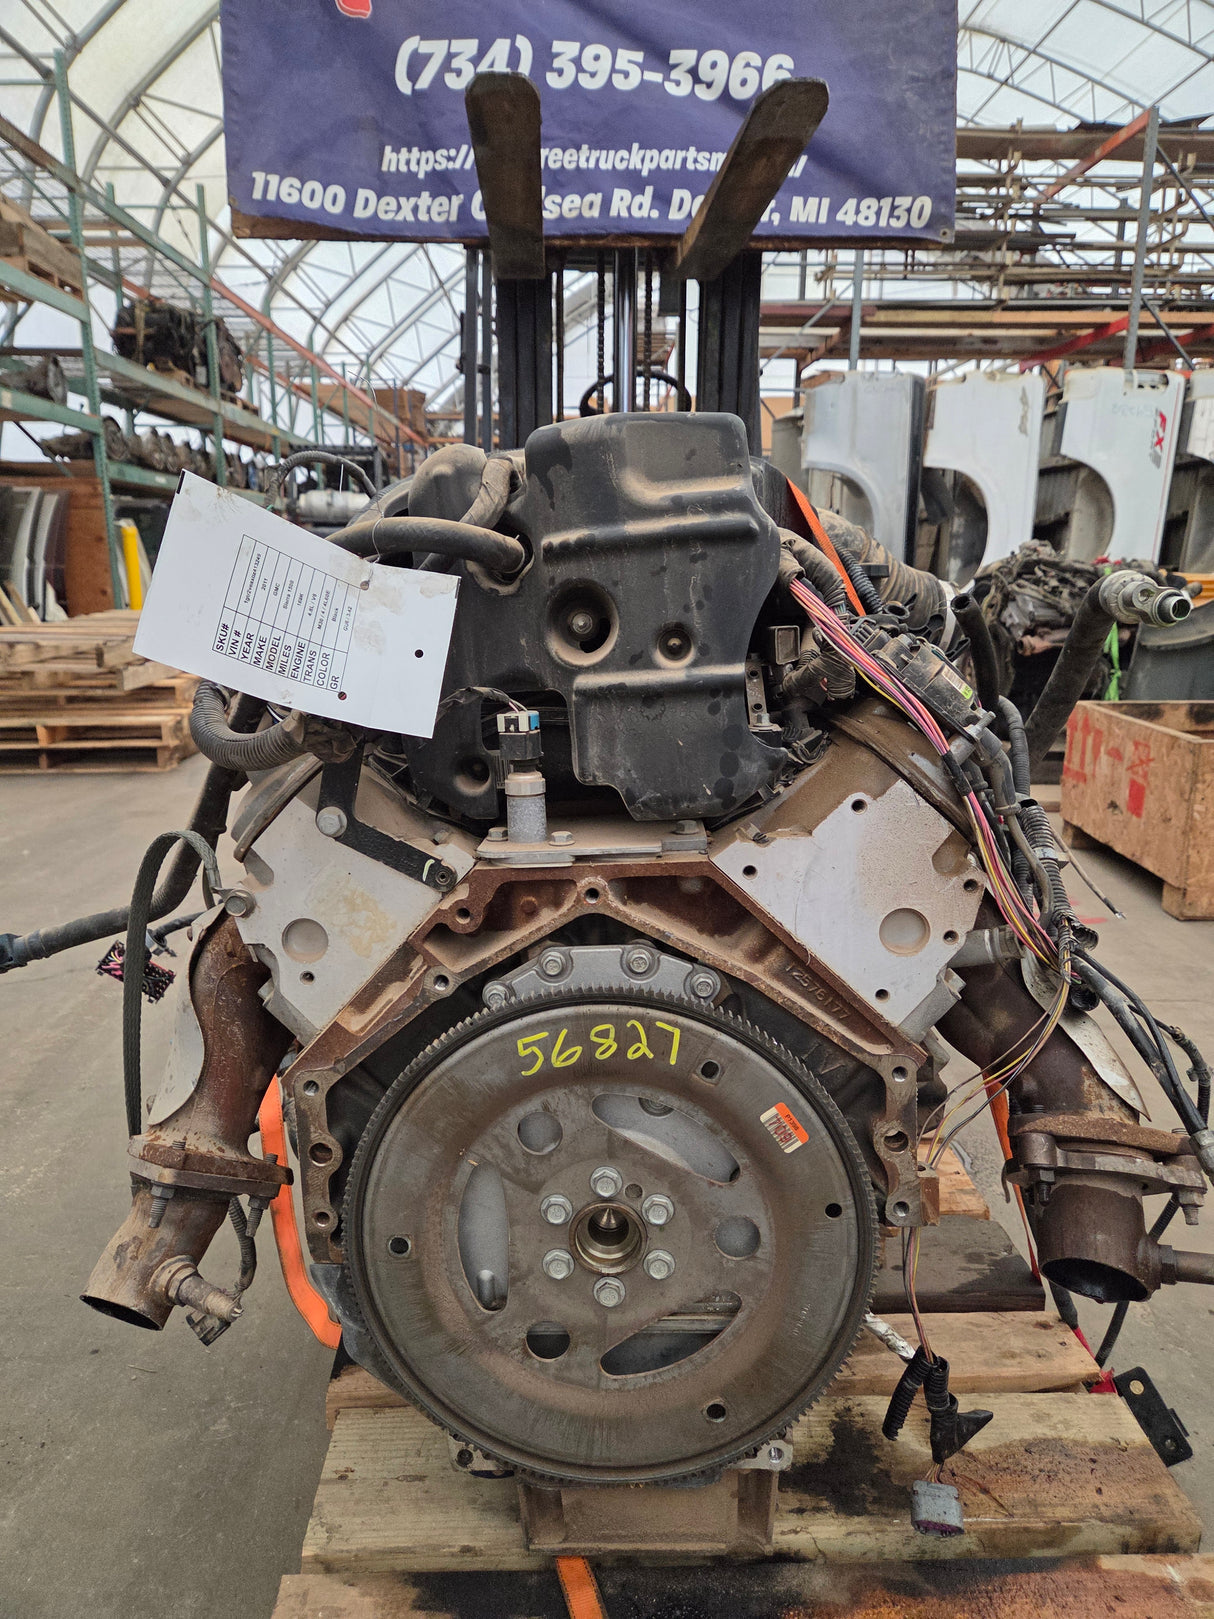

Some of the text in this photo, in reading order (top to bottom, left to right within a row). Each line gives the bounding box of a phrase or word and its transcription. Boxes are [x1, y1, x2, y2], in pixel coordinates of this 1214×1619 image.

[395, 34, 796, 101] (734) 395-3966
[252, 171, 346, 214] 11600
[353, 187, 464, 223] Dexter
[609, 185, 659, 219] Rd.
[789, 196, 830, 224] MI
[836, 196, 933, 228] 48130
[215, 623, 230, 652] SKU#
[228, 638, 240, 656] VIN
[240, 577, 269, 660] YEAR 2011
[252, 582, 281, 666] MAKE GMC
[265, 580, 295, 671] MODEL Sierra 1500
[316, 607, 339, 687] COLOR Black
[278, 644, 292, 675] MILES
[290, 641, 306, 680] ENGINE
[303, 649, 317, 682] TRANS
[329, 675, 340, 690] GR
[516, 1019, 681, 1077] 56827
